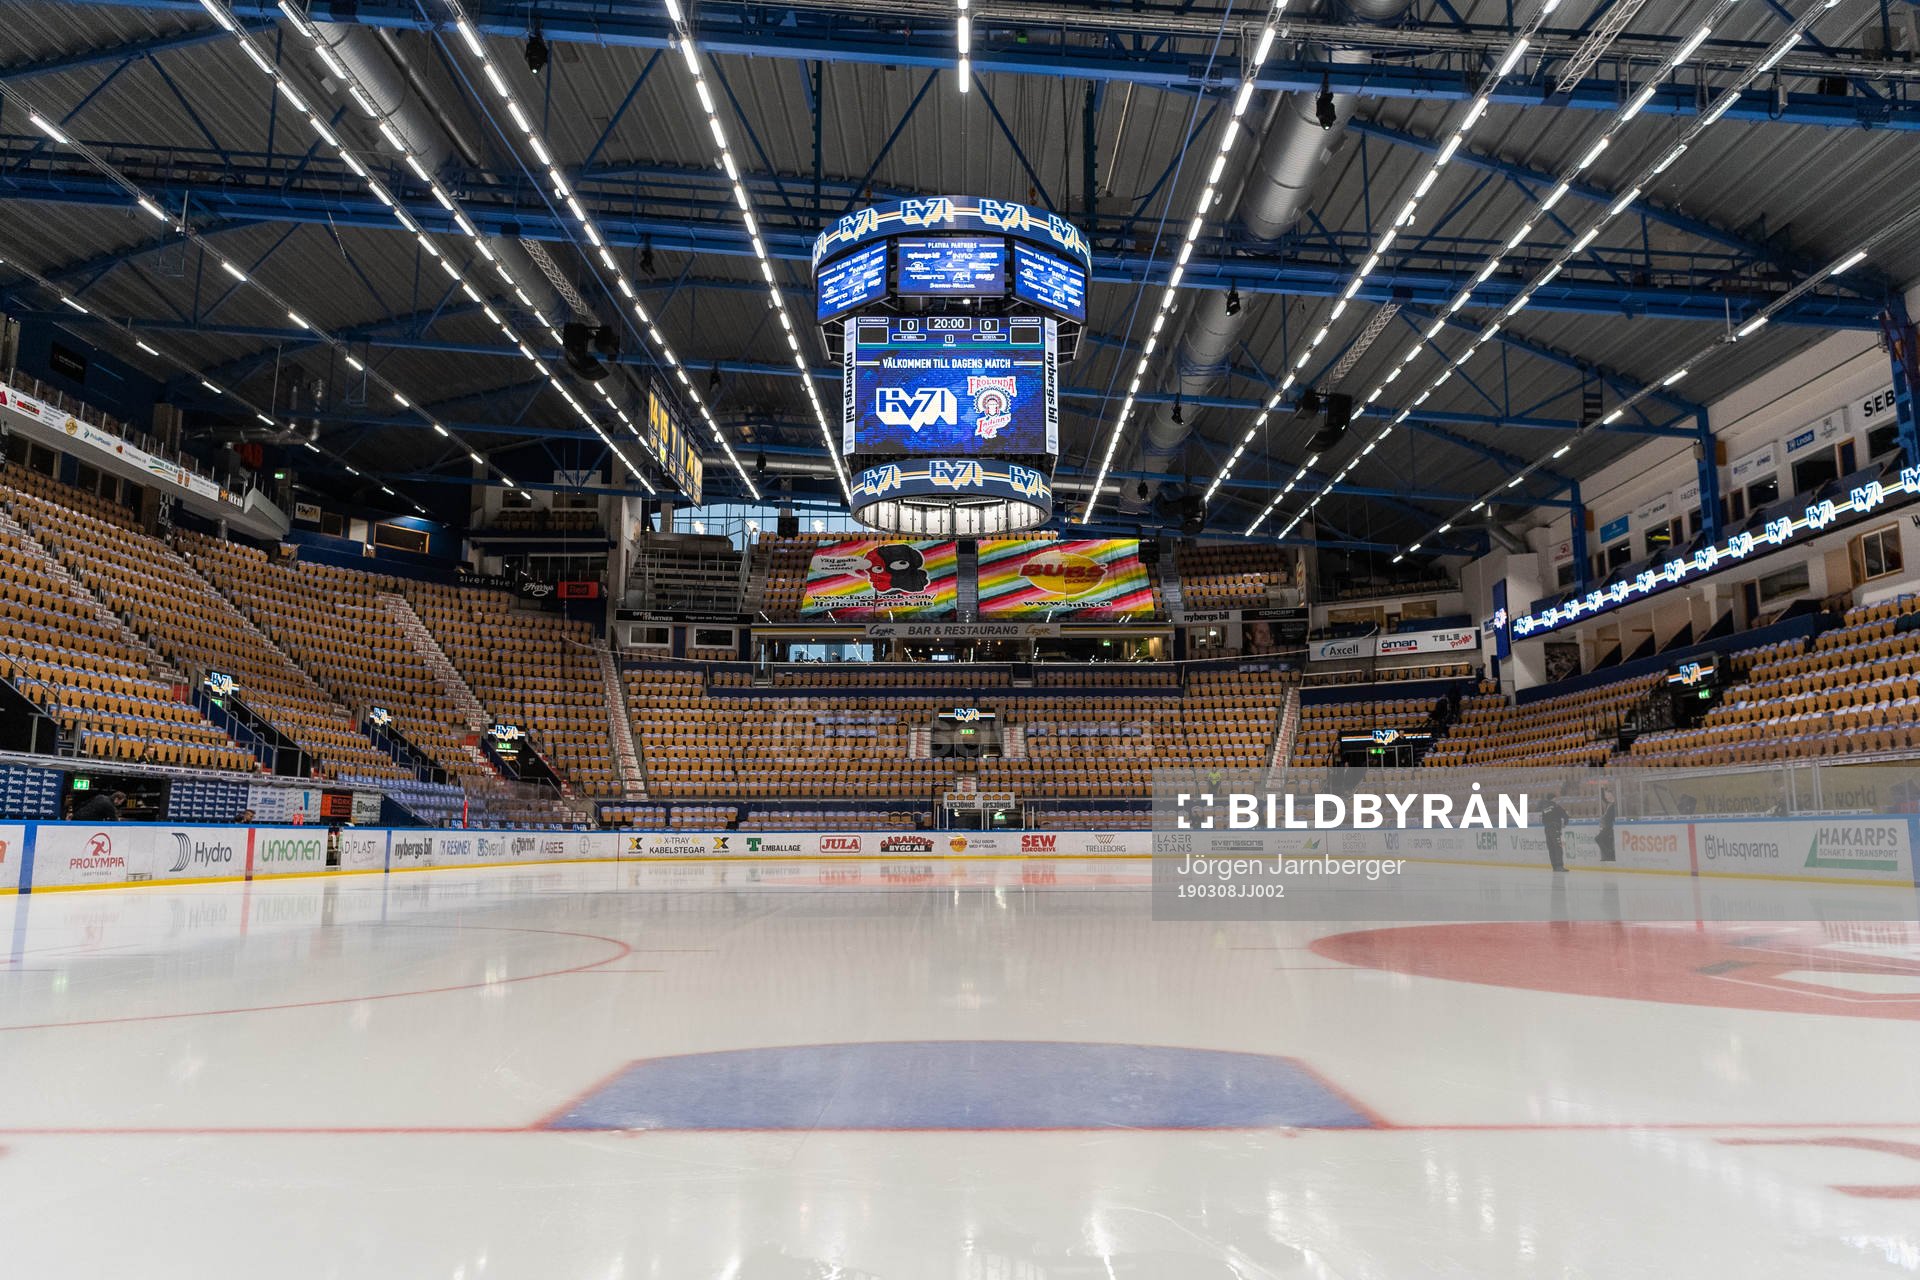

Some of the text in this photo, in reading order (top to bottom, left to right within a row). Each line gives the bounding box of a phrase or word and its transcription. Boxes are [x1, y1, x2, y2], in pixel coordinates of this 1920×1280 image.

[907, 321, 914, 330] 0
[934, 319, 964, 329] 20:00
[984, 321, 991, 330] 0
[883, 357, 1010, 368] VÄLKOMMEN TILL DAGENS MATCH
[845, 352, 855, 424] nybergs bil
[1048, 352, 1058, 424] nybergs bil
[876, 388, 957, 432] HV71
[1863, 390, 1895, 417] SEB
[929, 460, 983, 490] HV71
[1851, 481, 1884, 512] HV71
[1020, 564, 1106, 578] BUBS
[1184, 611, 1229, 622] nybergs bil
[908, 626, 1018, 635] BAR & RESTAURANG
[1382, 638, 1417, 648] öman
[1329, 644, 1359, 656] Axcell
[664, 837, 690, 845] X-TRAY
[1022, 835, 1056, 847] SEW
[1157, 835, 1192, 843] LASER
[1622, 831, 1678, 852] Passera
[1819, 827, 1898, 846] HAKARPS
[353, 841, 376, 854] PLAST
[395, 838, 432, 859] nybergs bil
[822, 839, 859, 849] JULA
[1157, 844, 1192, 853] STANS
[1716, 838, 1779, 860] Husqvarna
[195, 842, 232, 866] Hydro
[261, 840, 321, 862] UNIONEN
[1819, 849, 1845, 857] SCHAKT
[1855, 849, 1898, 858] TRANSPORT
[70, 856, 125, 870] PROLYMPIA
